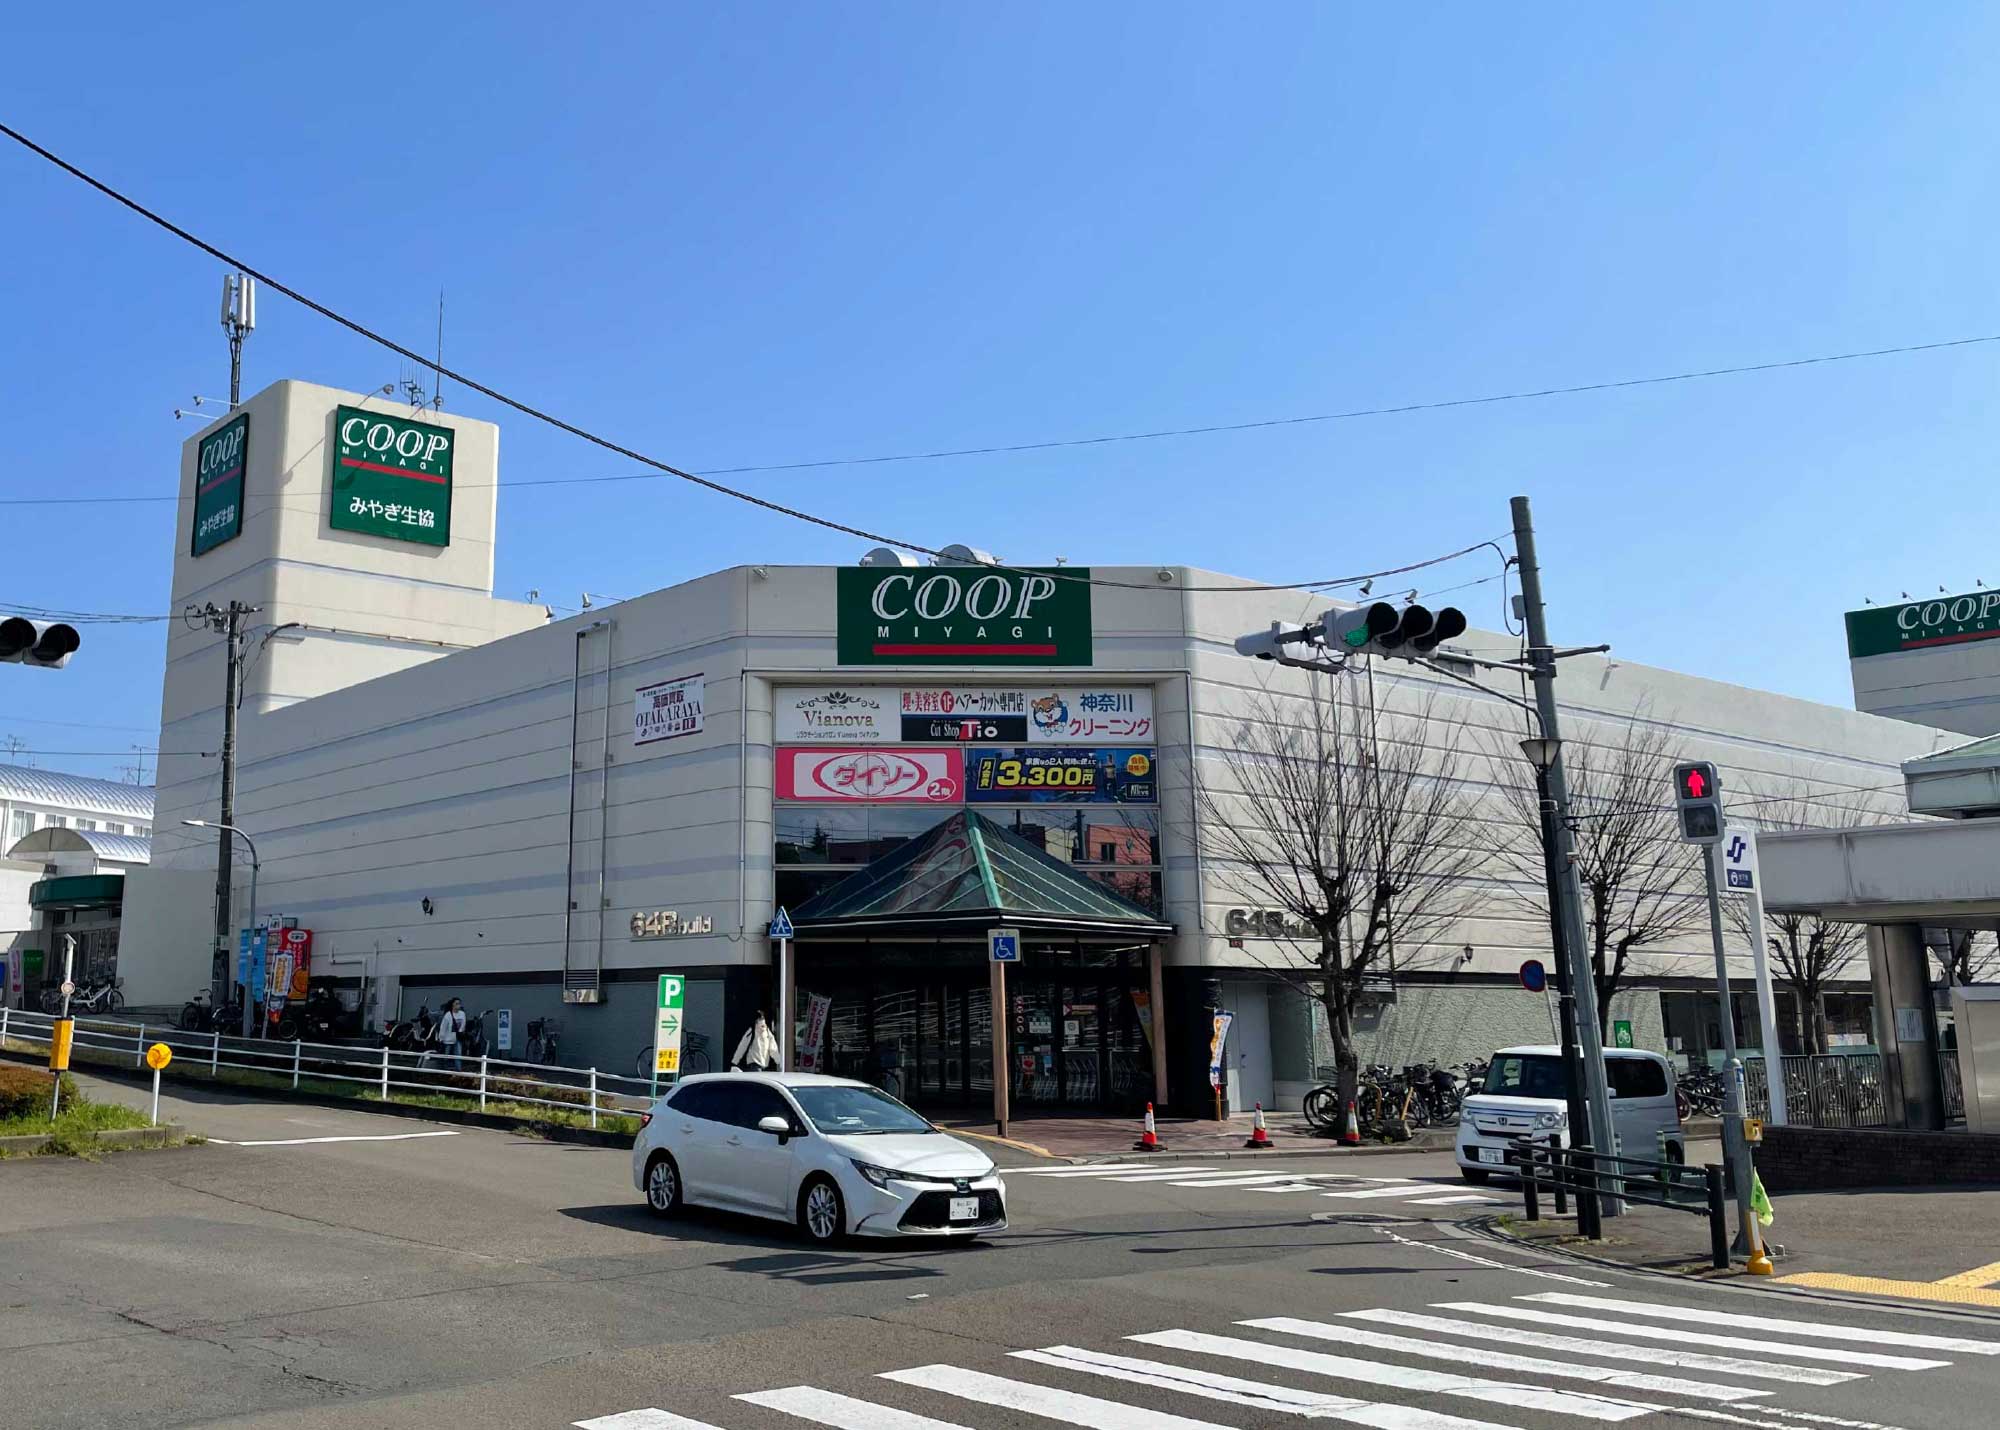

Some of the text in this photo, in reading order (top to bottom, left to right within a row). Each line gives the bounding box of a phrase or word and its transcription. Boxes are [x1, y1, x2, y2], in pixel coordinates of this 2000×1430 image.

[201, 426, 245, 474] COOP
[342, 417, 449, 462] COOP
[342, 447, 443, 473] MIYAGI
[350, 497, 435, 528] みやぎ生協
[871, 574, 1056, 620] COOP
[1897, 593, 2000, 630] COOP
[878, 626, 1052, 639] MIYAGI
[635, 700, 702, 727] OTAKARAYA
[1080, 693, 1133, 712] 神奈川
[803, 710, 874, 727] Vianova
[944, 722, 960, 740] Shop
[960, 721, 998, 738] Tio
[1069, 717, 1151, 736] クリーニング
[833, 761, 915, 786] ダイソー
[664, 978, 681, 1005] P
